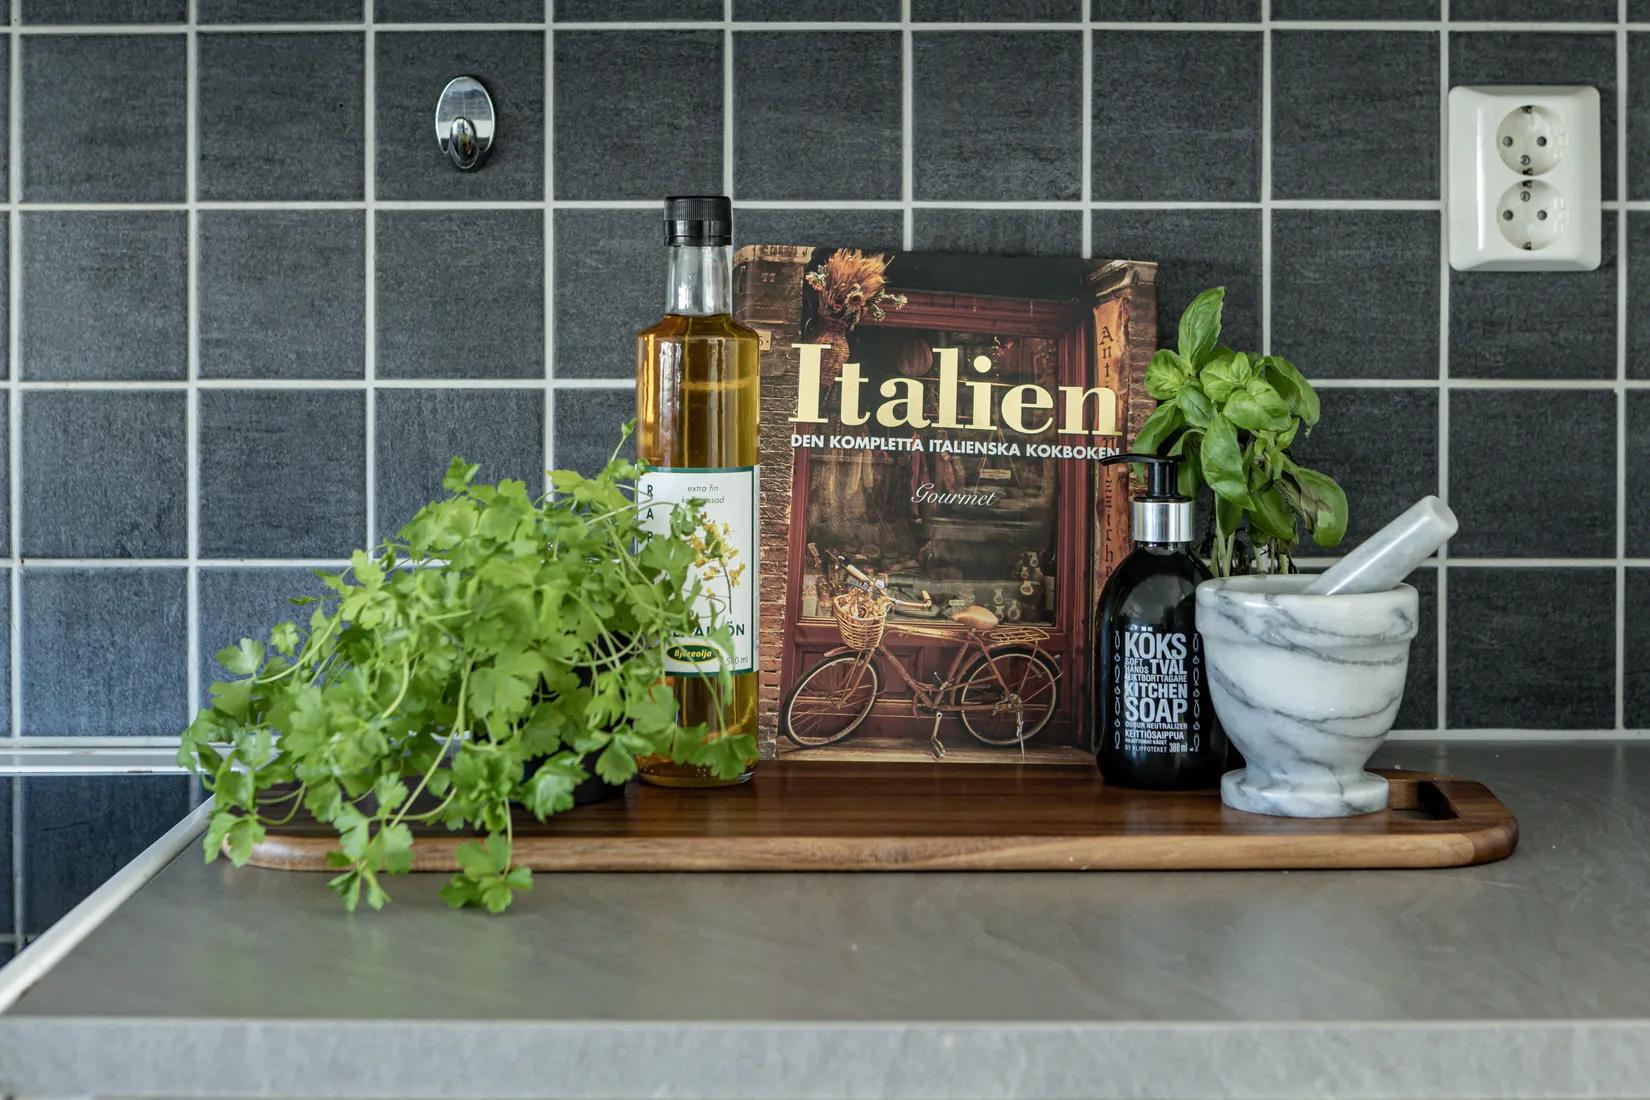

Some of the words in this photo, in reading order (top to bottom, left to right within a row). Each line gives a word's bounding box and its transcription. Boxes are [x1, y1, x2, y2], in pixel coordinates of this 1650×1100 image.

[788, 343, 1123, 436] Italien
[790, 434, 824, 448] DEN
[829, 436, 924, 452] KOMPLETTA
[929, 439, 1021, 457] ITALIENSKA
[1026, 444, 1120, 460] KOKBOKEN
[709, 484, 719, 492] fin
[911, 482, 998, 507] Gourmet
[1124, 626, 1187, 660] KÖKS
[740, 655, 749, 663] ml
[1125, 657, 1144, 667] SOFT
[1149, 657, 1188, 675] TVÅL
[1125, 665, 1149, 674] HANDS
[1124, 682, 1188, 699] KITCHEN
[1124, 697, 1188, 723] SOAP
[1125, 729, 1185, 740] KEITTIÖSAIPPUA
[1146, 722, 1188, 730] NEUTRALIZER
